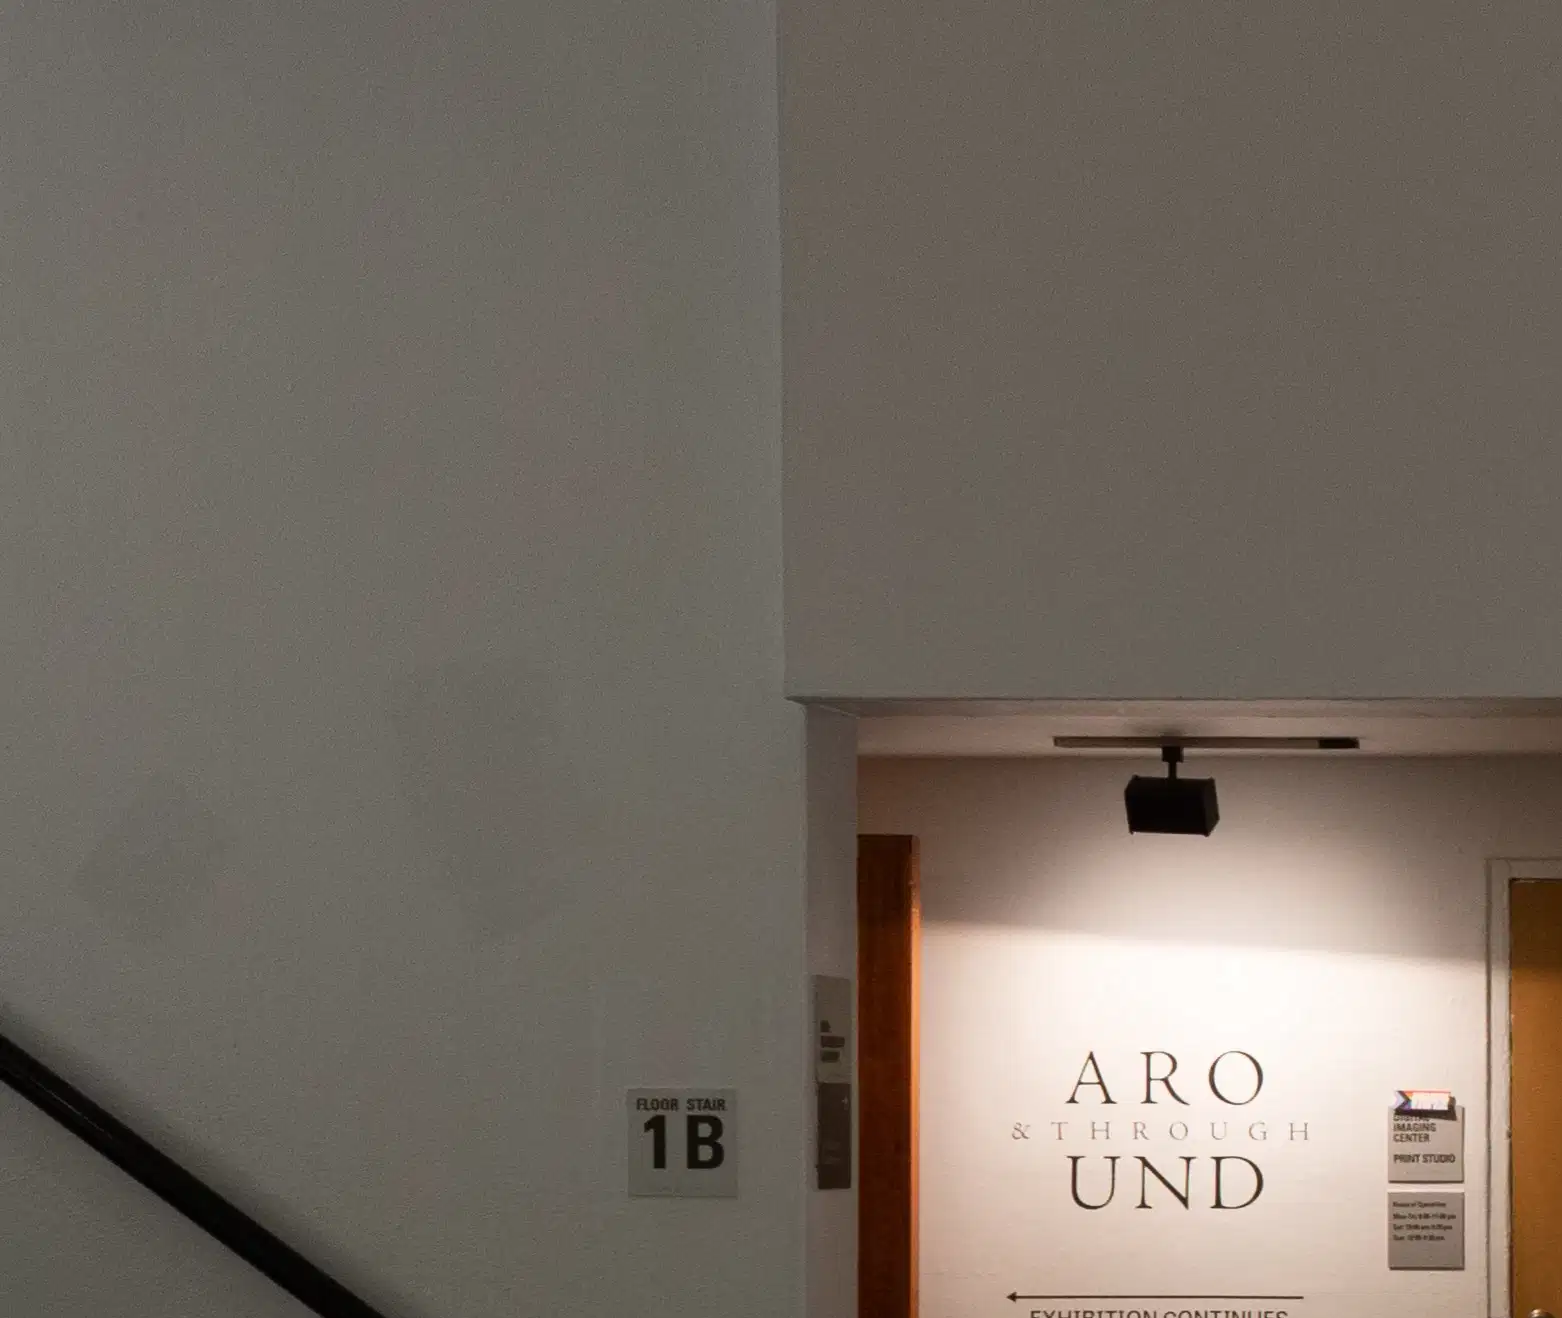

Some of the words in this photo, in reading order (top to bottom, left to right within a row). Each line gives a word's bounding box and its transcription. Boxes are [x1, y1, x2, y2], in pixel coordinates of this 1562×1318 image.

[1065, 1050, 1264, 1106] ARO
[636, 1097, 679, 1112] FLOOR
[686, 1097, 726, 1112] STAIR
[1050, 1121, 1310, 1141] THROUGH
[1393, 1123, 1437, 1132] IMAGING
[1393, 1133, 1430, 1143] CENTER
[1393, 1153, 1420, 1164] PRINT
[1422, 1153, 1456, 1164] STUDIO
[1066, 1155, 1264, 1211] UND
